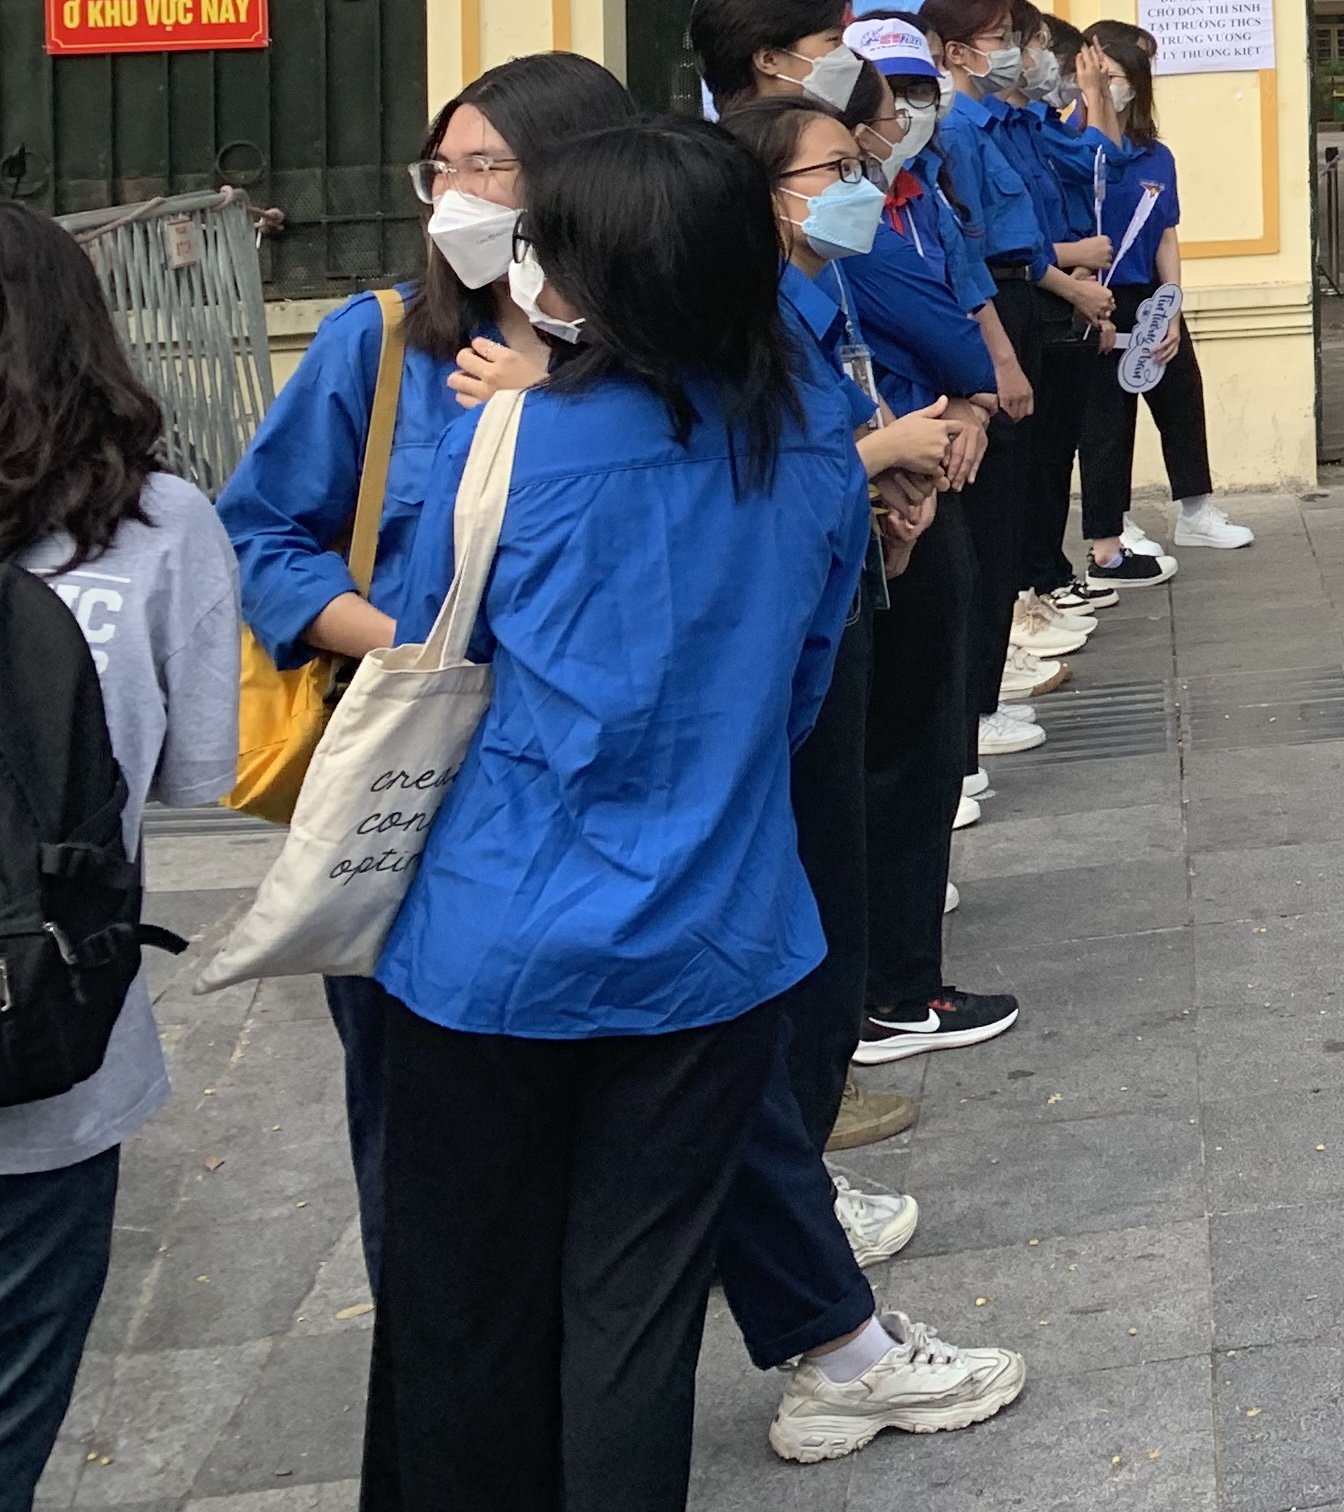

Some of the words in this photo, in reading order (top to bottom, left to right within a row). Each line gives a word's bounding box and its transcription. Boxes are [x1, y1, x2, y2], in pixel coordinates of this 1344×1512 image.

[1147, 7, 1174, 18] CHỜ
[1232, 4, 1260, 13] SINH
[1148, 22, 1169, 33] TẠI
[1173, 19, 1226, 30] TRƯỜNG
[1230, 18, 1261, 28] THCS
[1163, 49, 1178, 60] LÝ
[1182, 47, 1231, 59] THƯỜNG
